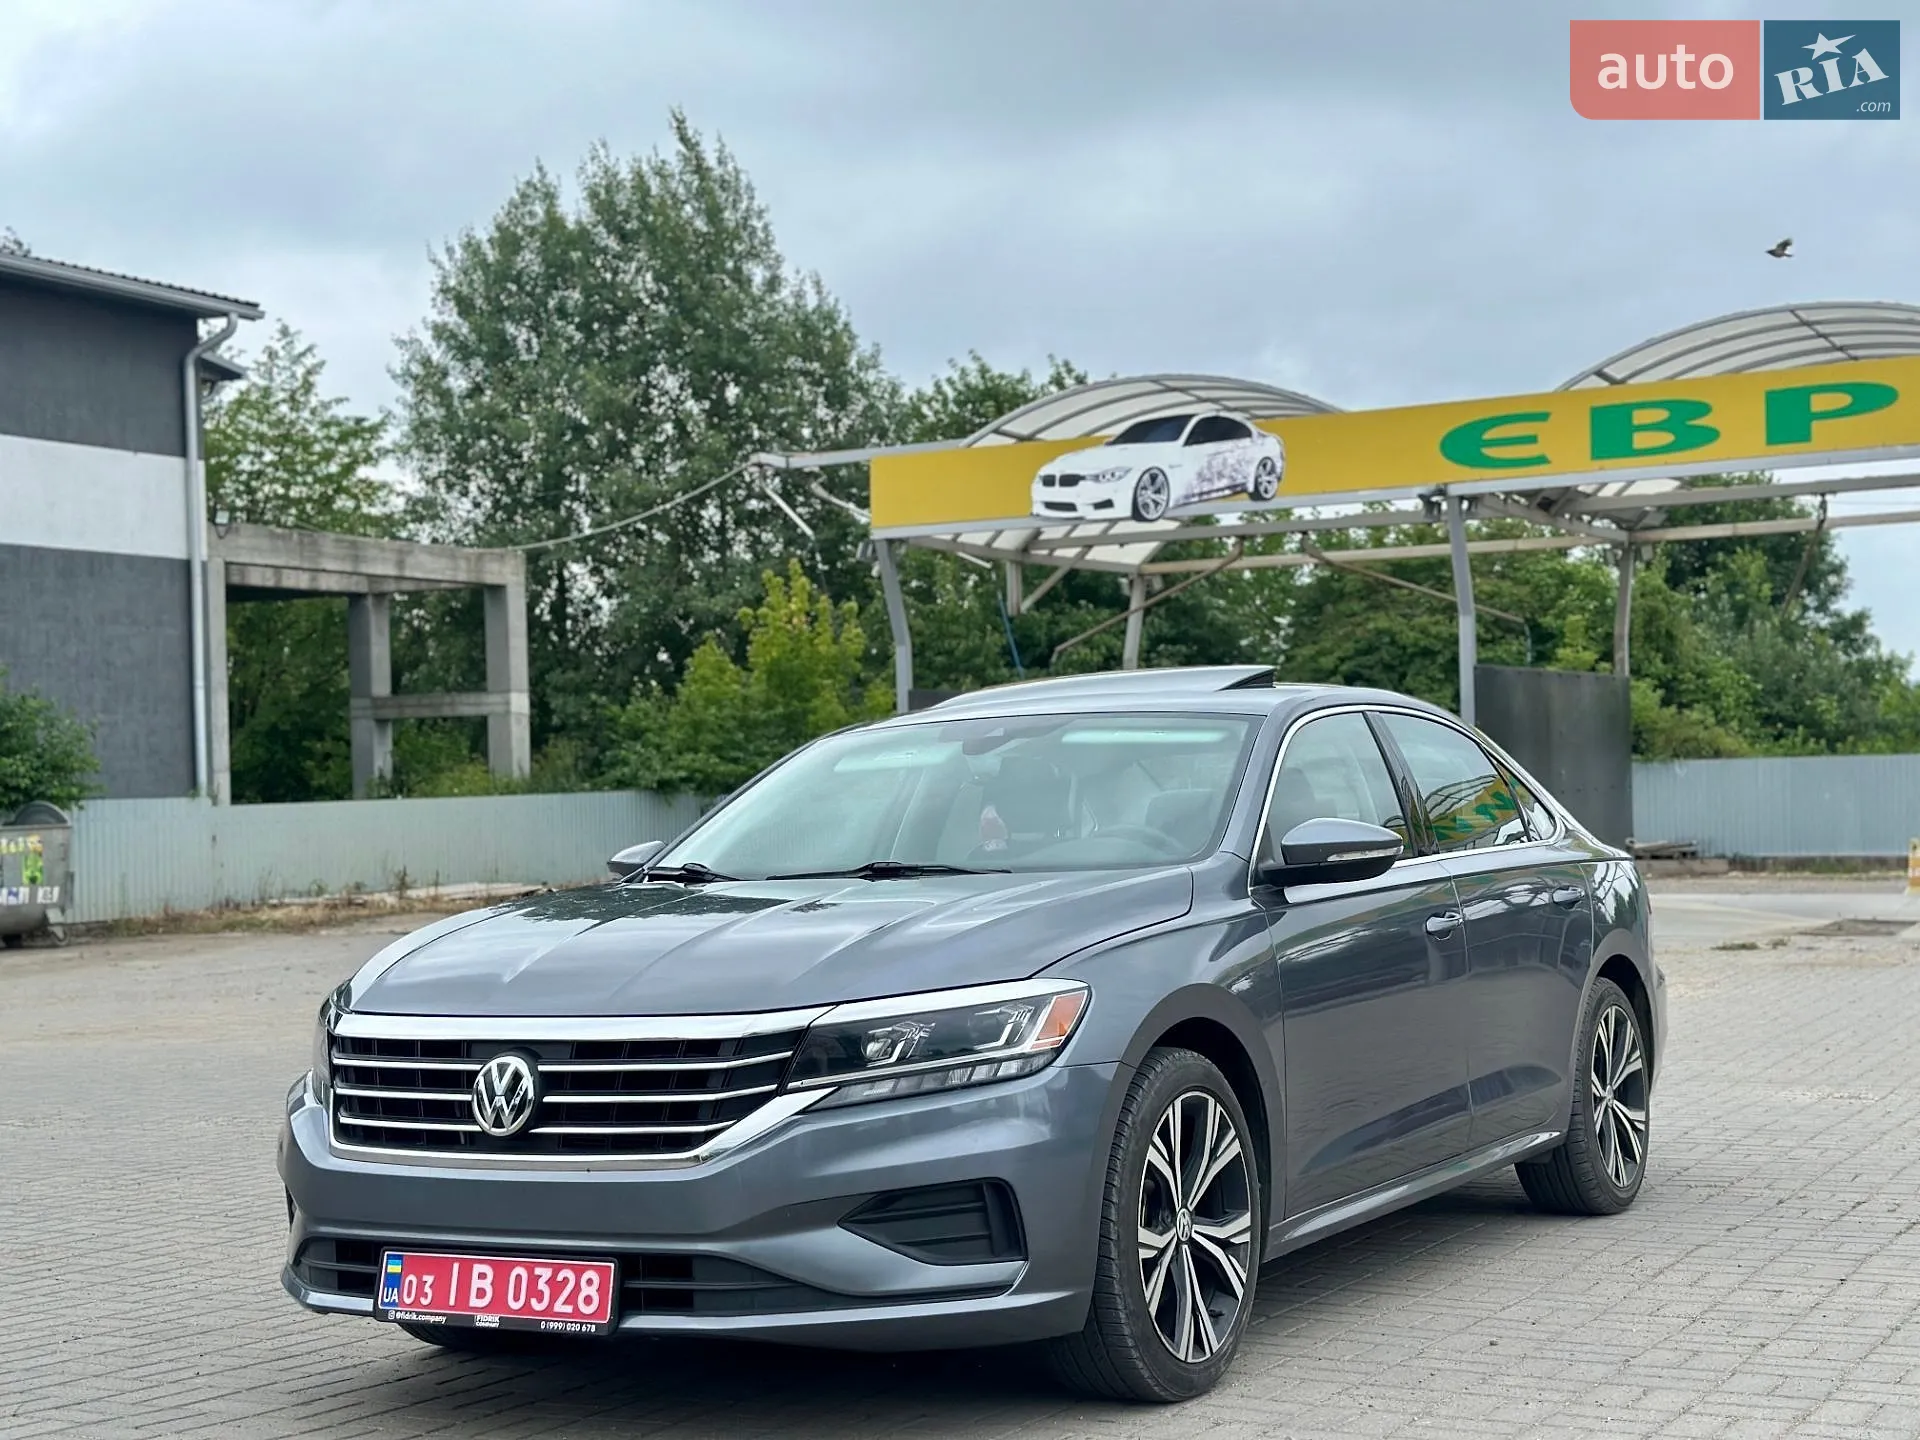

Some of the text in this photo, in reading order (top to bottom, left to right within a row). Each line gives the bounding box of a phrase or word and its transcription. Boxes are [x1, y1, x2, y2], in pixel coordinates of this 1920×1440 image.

[474, 1057, 532, 1134] VW
[383, 1287, 399, 1303] UA
[402, 1274, 436, 1306] 03
[507, 1266, 601, 1315] 0328
